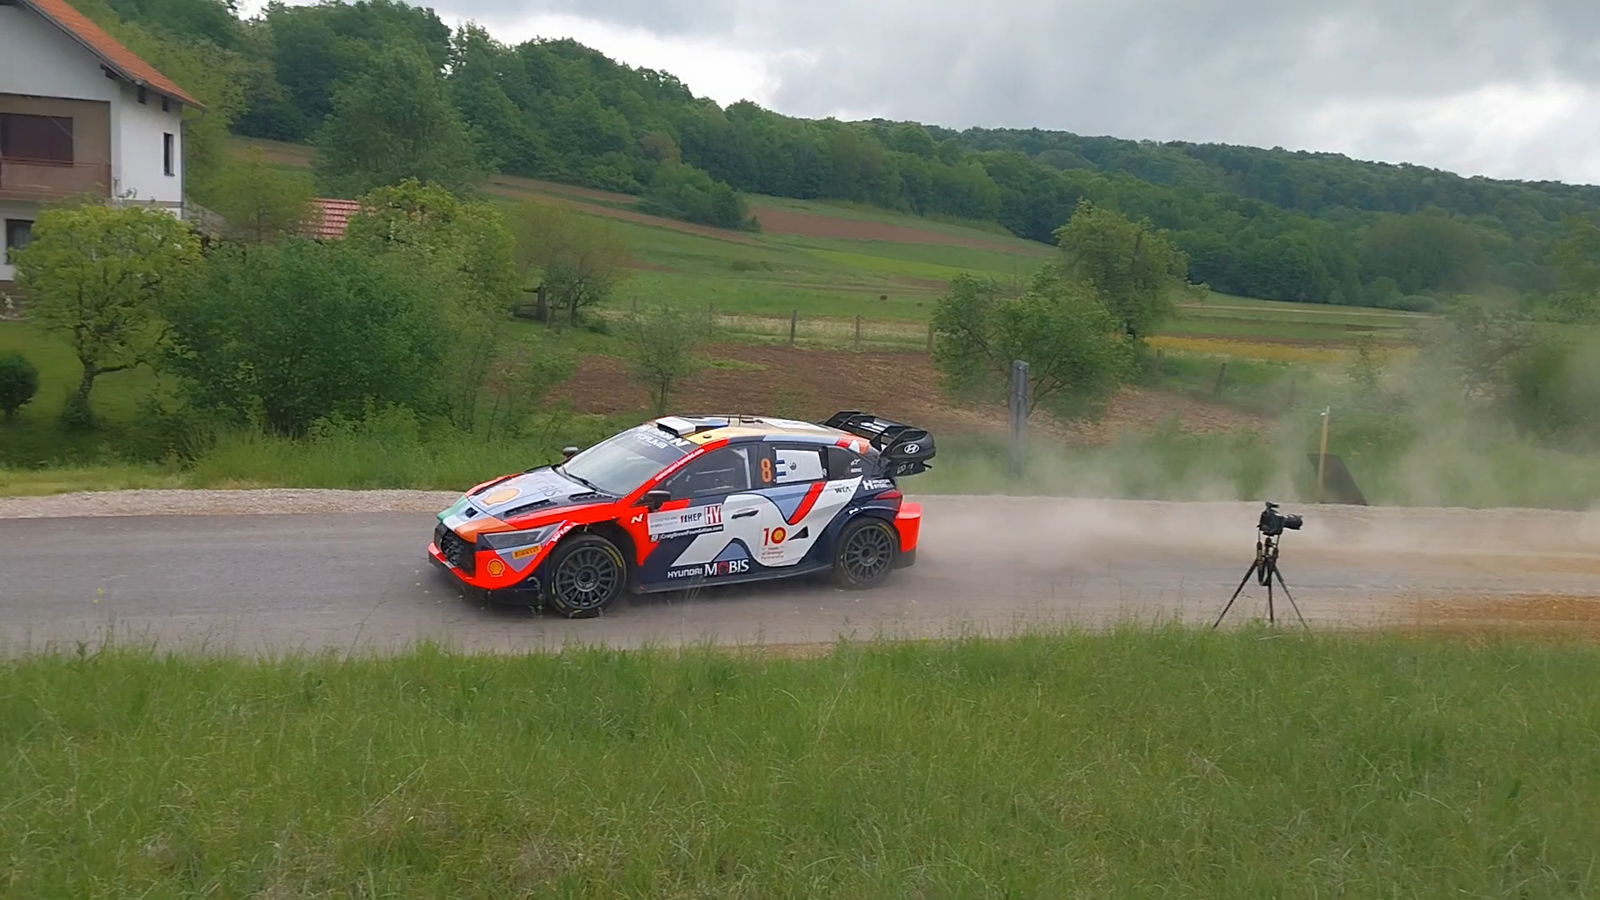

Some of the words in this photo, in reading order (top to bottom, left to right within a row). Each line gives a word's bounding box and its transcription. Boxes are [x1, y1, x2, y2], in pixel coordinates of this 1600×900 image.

[760, 457, 772, 483] 8
[704, 505, 722, 525] HY
[667, 567, 703, 578] HYUNDAI
[704, 559, 750, 577] MOBIS
